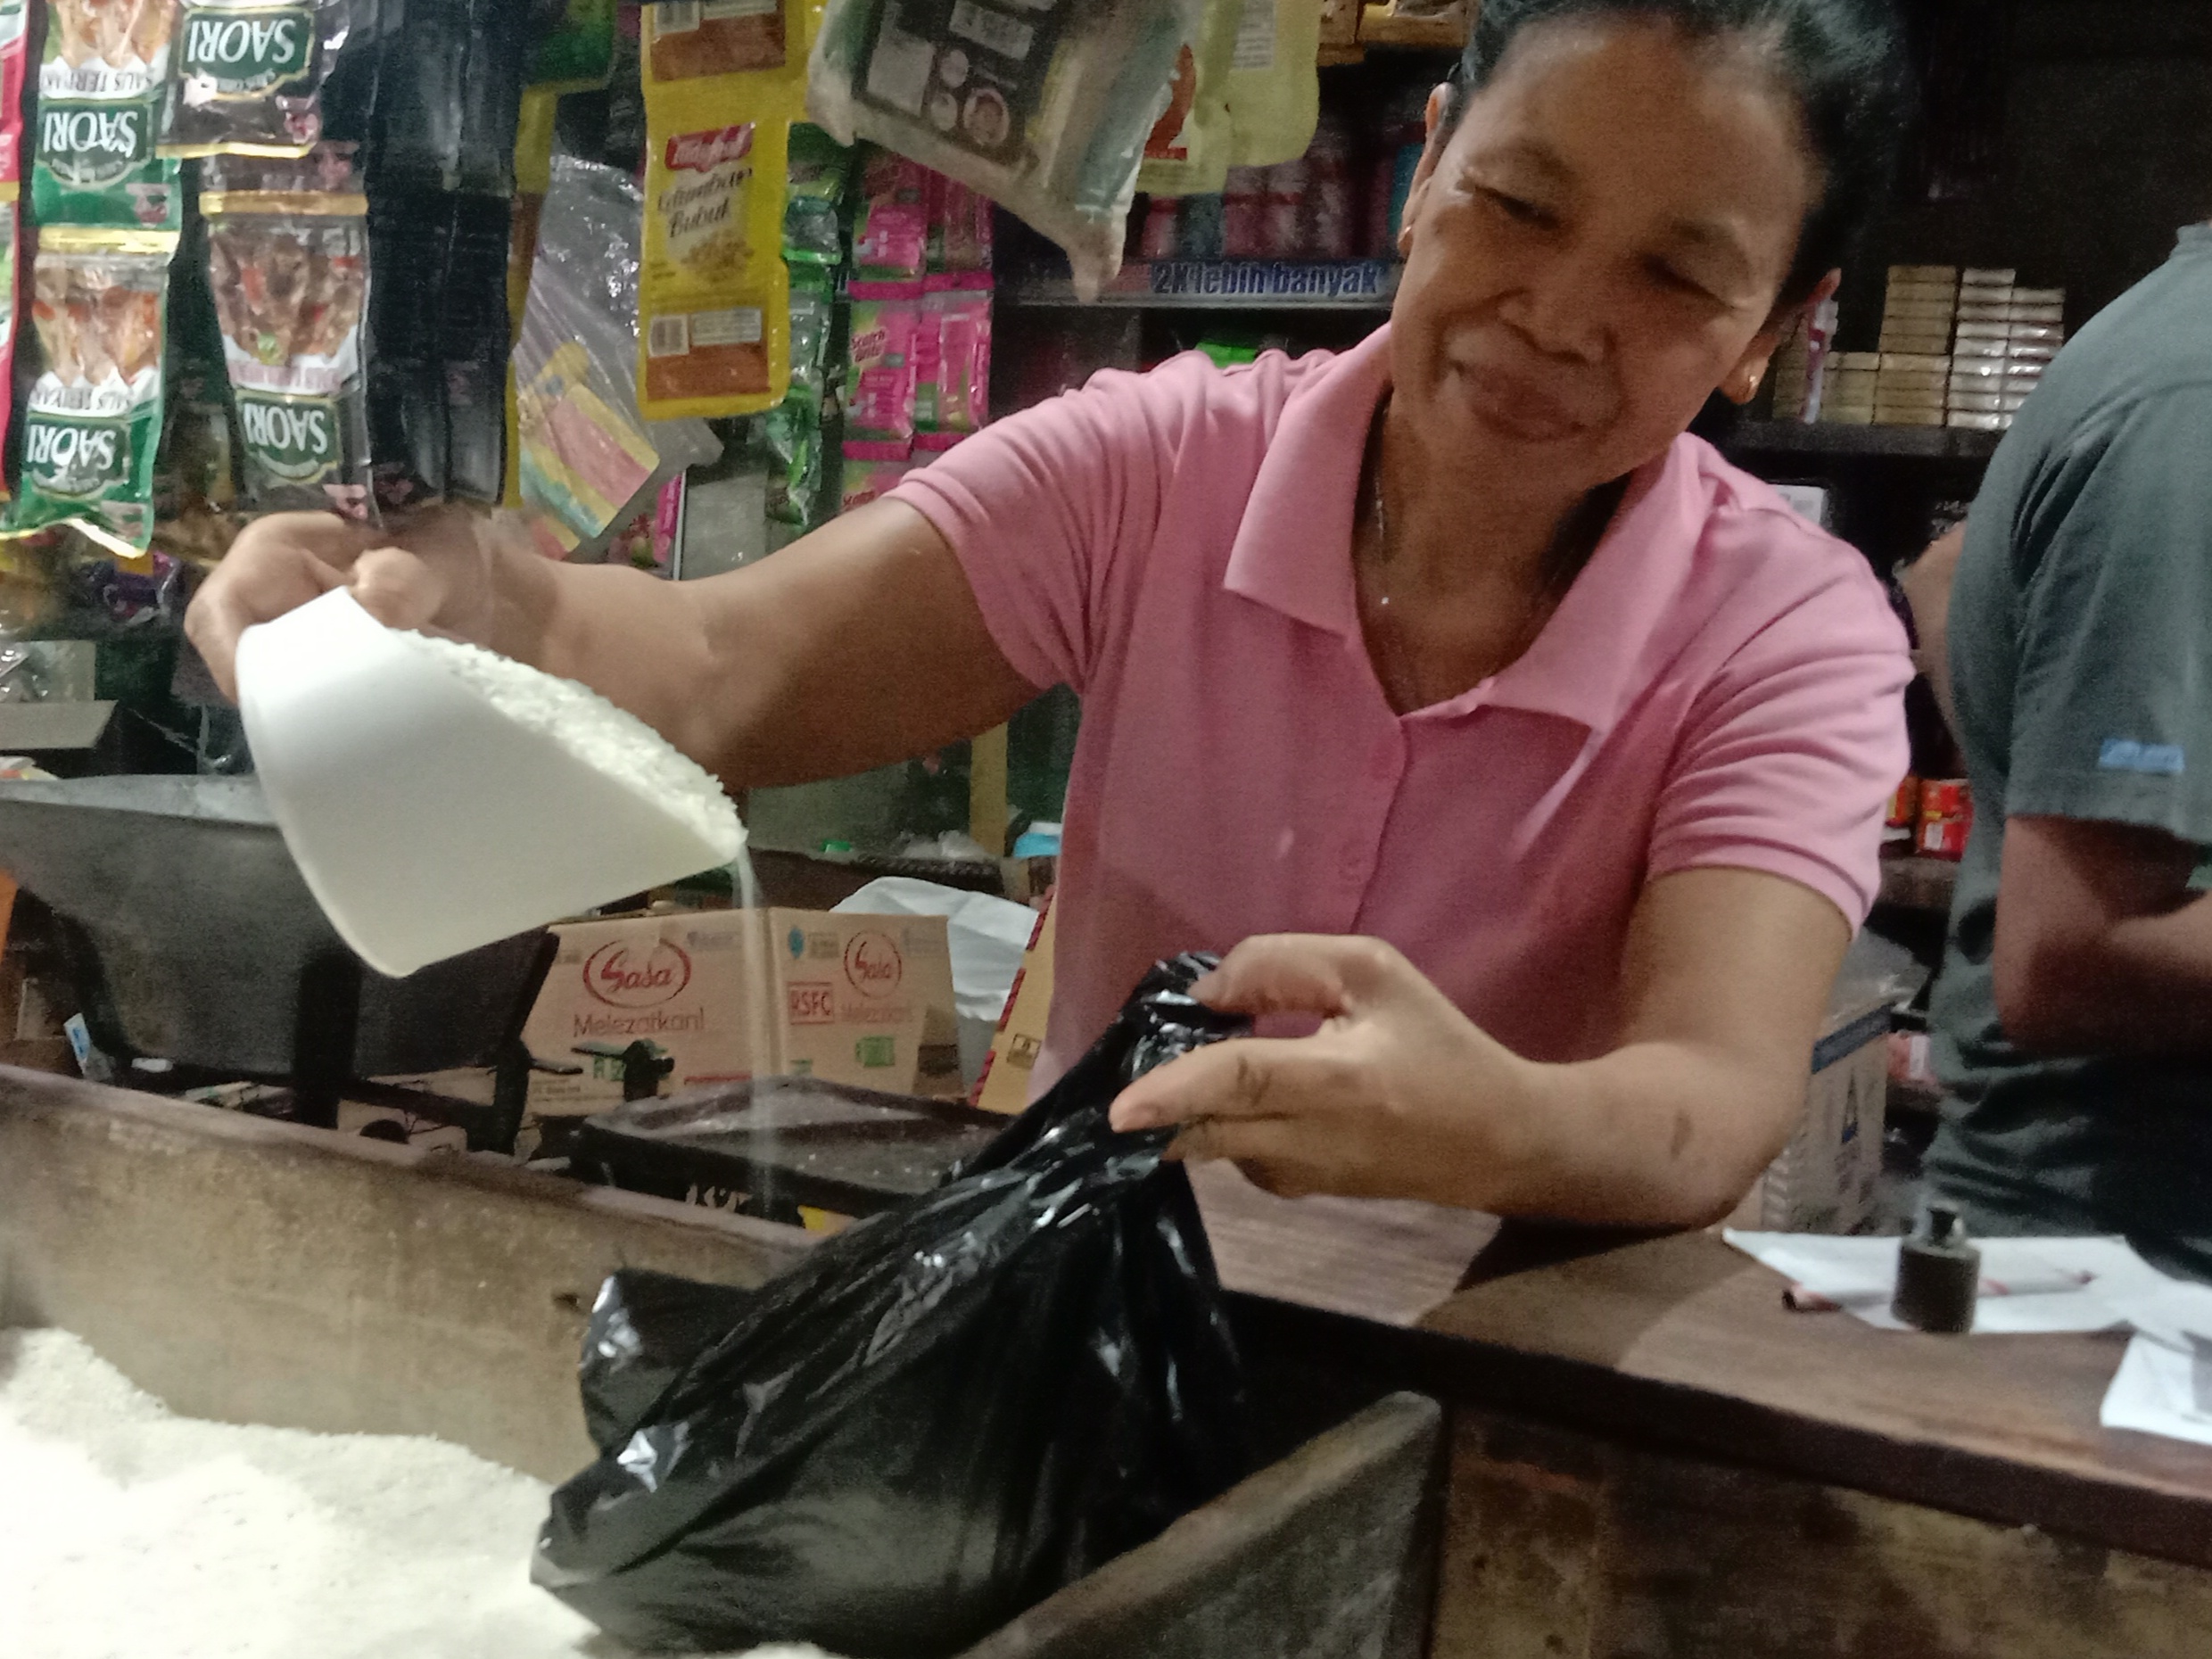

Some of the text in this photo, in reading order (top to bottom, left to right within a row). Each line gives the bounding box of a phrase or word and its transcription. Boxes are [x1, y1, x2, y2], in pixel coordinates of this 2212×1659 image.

[187, 18, 296, 64] SAORI
[43, 111, 139, 159] SAORI
[1273, 262, 1377, 296] banyak
[26, 424, 117, 471] SAORI
[243, 402, 328, 455] SAORI
